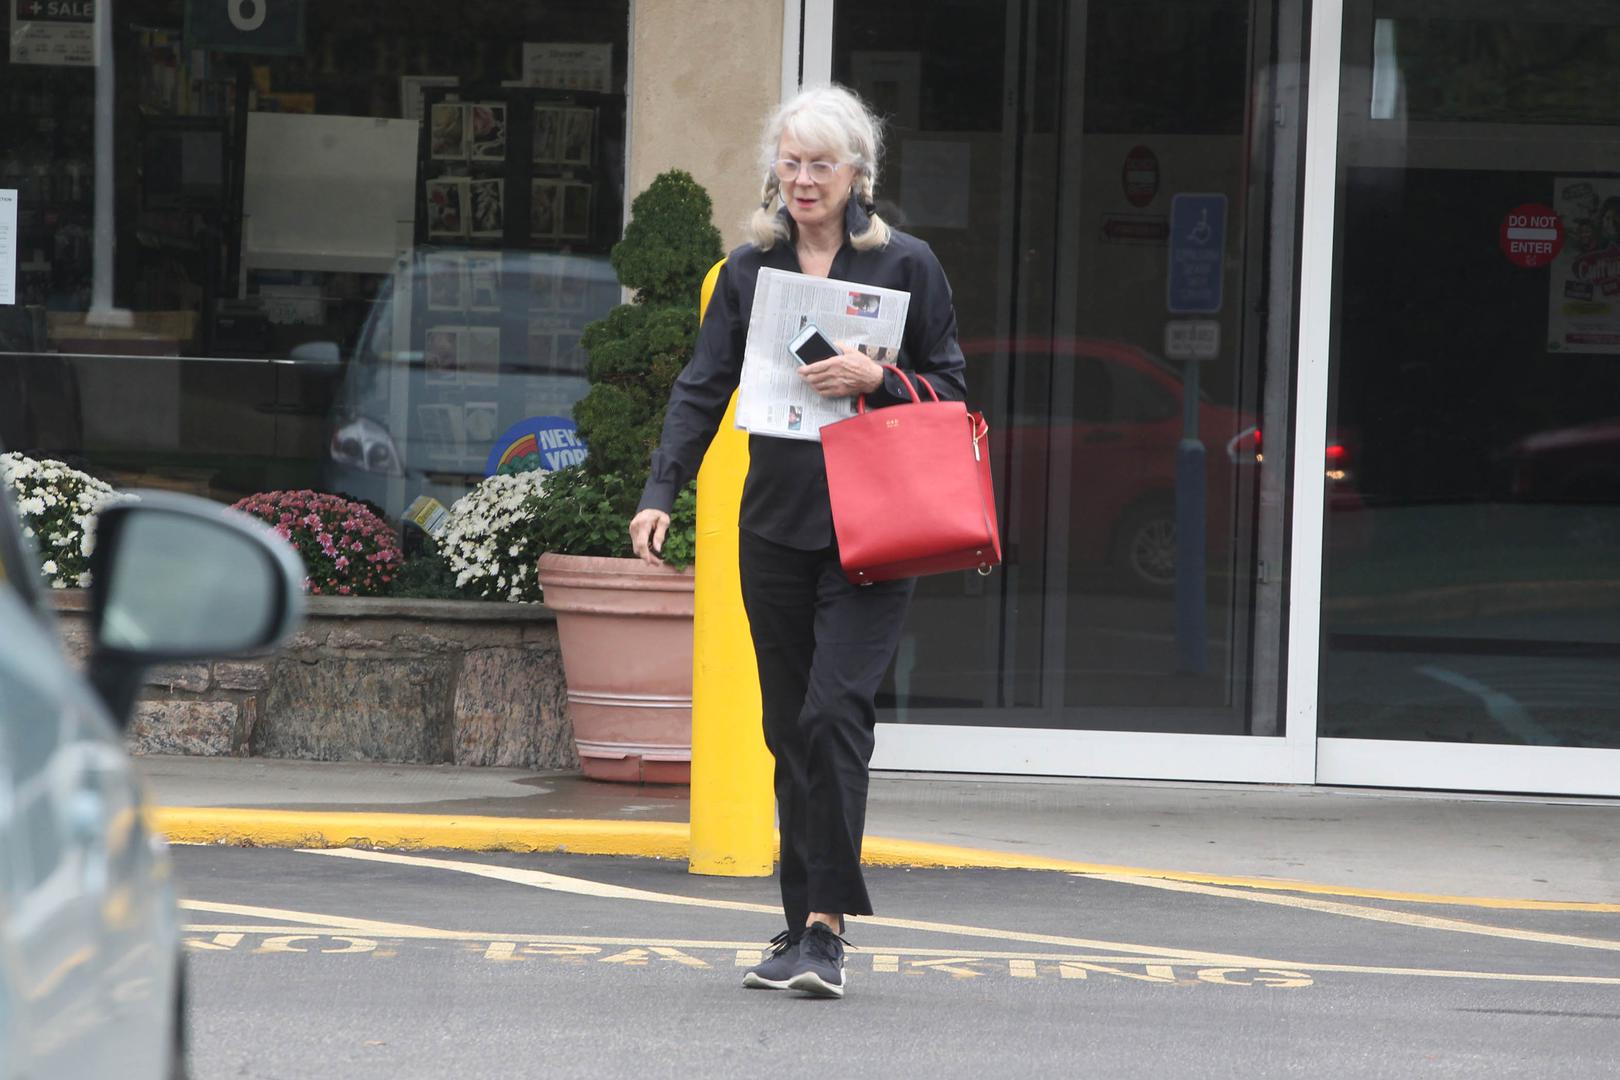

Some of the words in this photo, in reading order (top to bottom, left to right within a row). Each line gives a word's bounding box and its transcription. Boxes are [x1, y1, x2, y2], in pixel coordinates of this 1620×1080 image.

[47, 1, 93, 16] SALE
[1508, 215, 1528, 227] DO
[1530, 216, 1557, 228] NOT
[1510, 241, 1553, 254] ENTER
[545, 448, 589, 472] YOR
